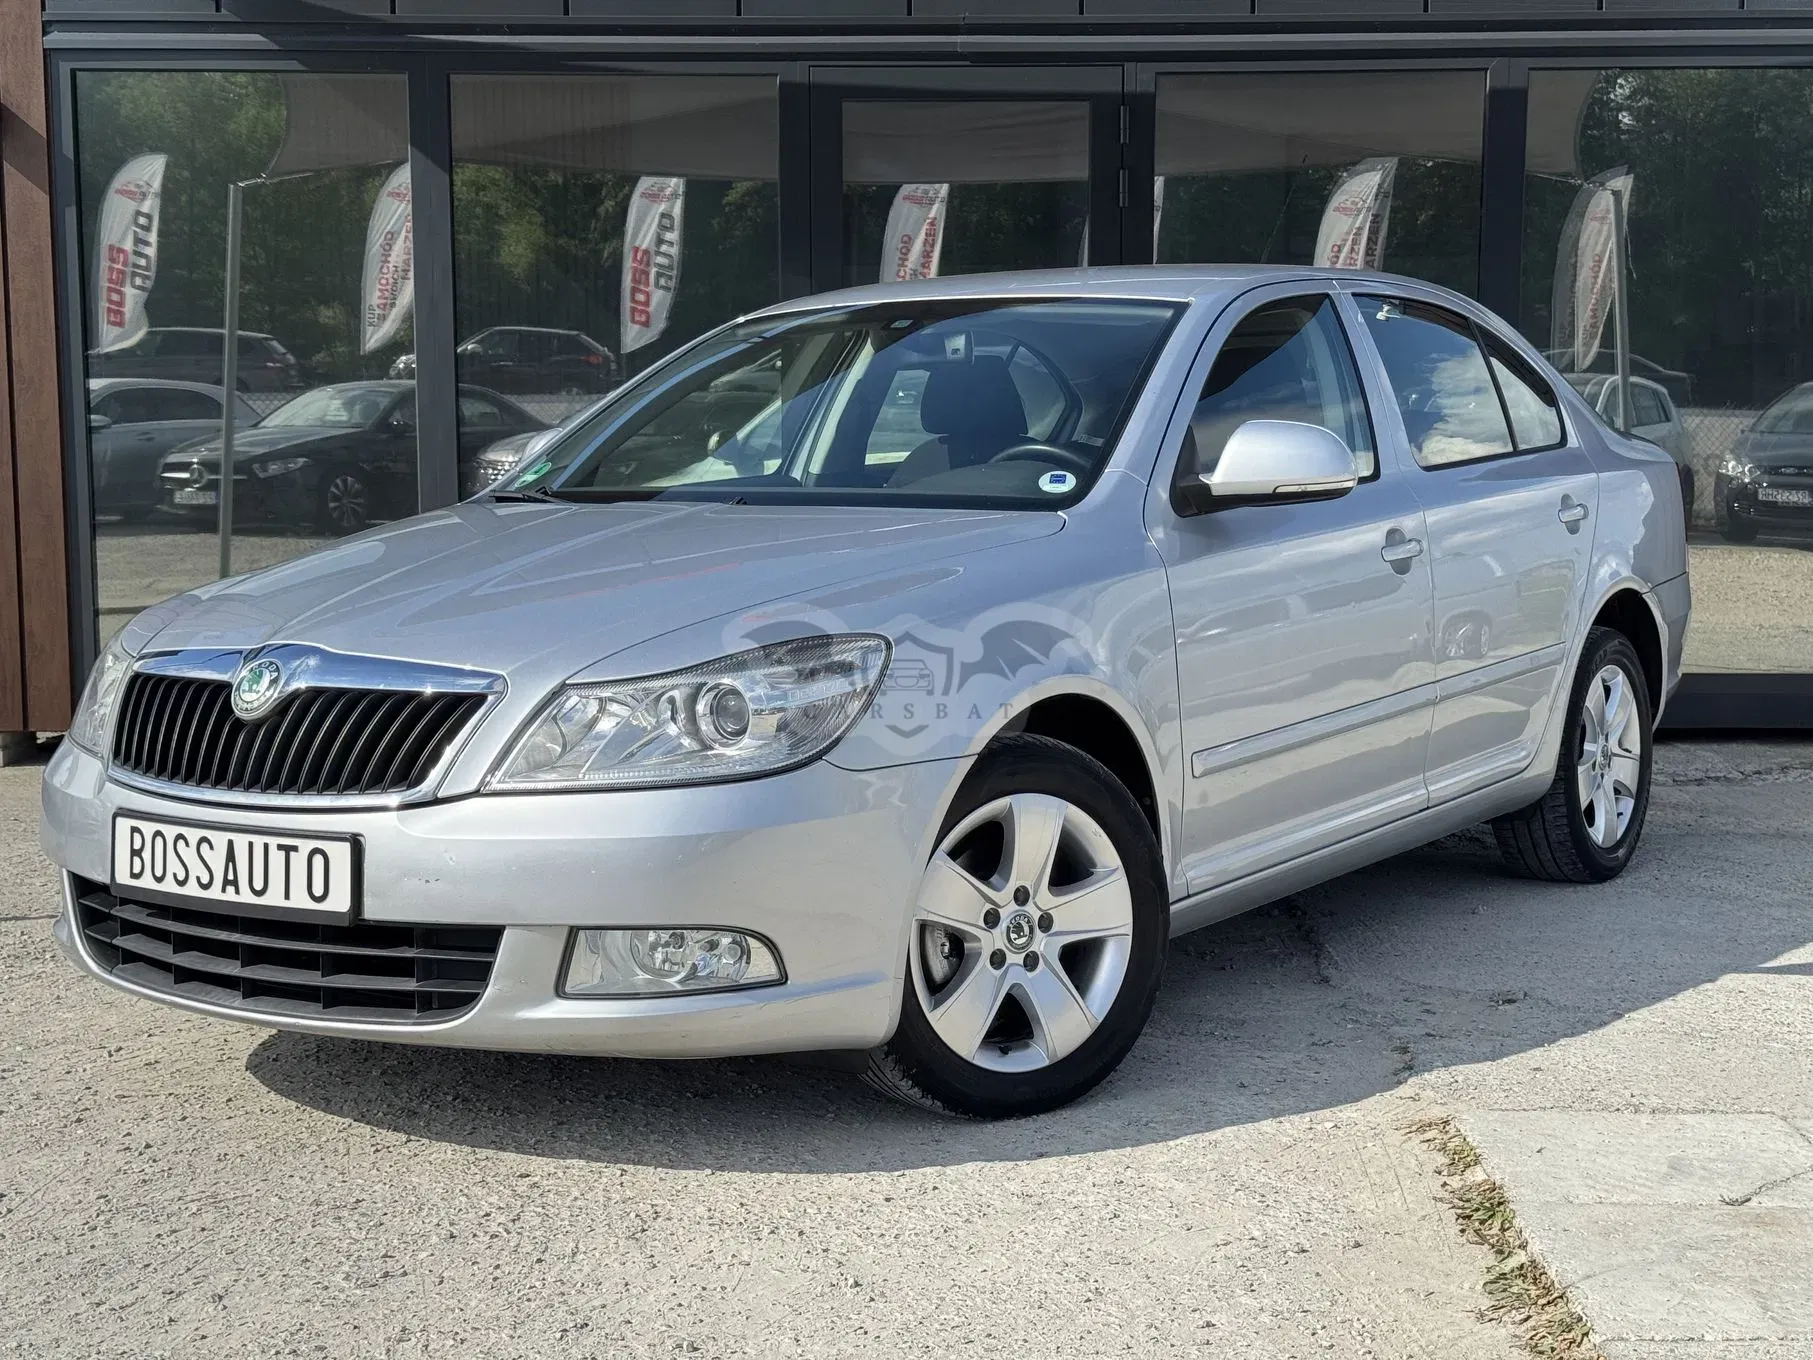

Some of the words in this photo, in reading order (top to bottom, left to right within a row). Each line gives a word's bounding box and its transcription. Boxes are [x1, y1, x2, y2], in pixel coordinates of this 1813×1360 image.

[106, 244, 129, 328] BOSS
[131, 209, 153, 293] AUTO
[629, 245, 651, 328] BOSS
[653, 211, 676, 293] AUTO
[367, 304, 377, 328] KUP
[129, 825, 330, 903] BOSSAUTO
